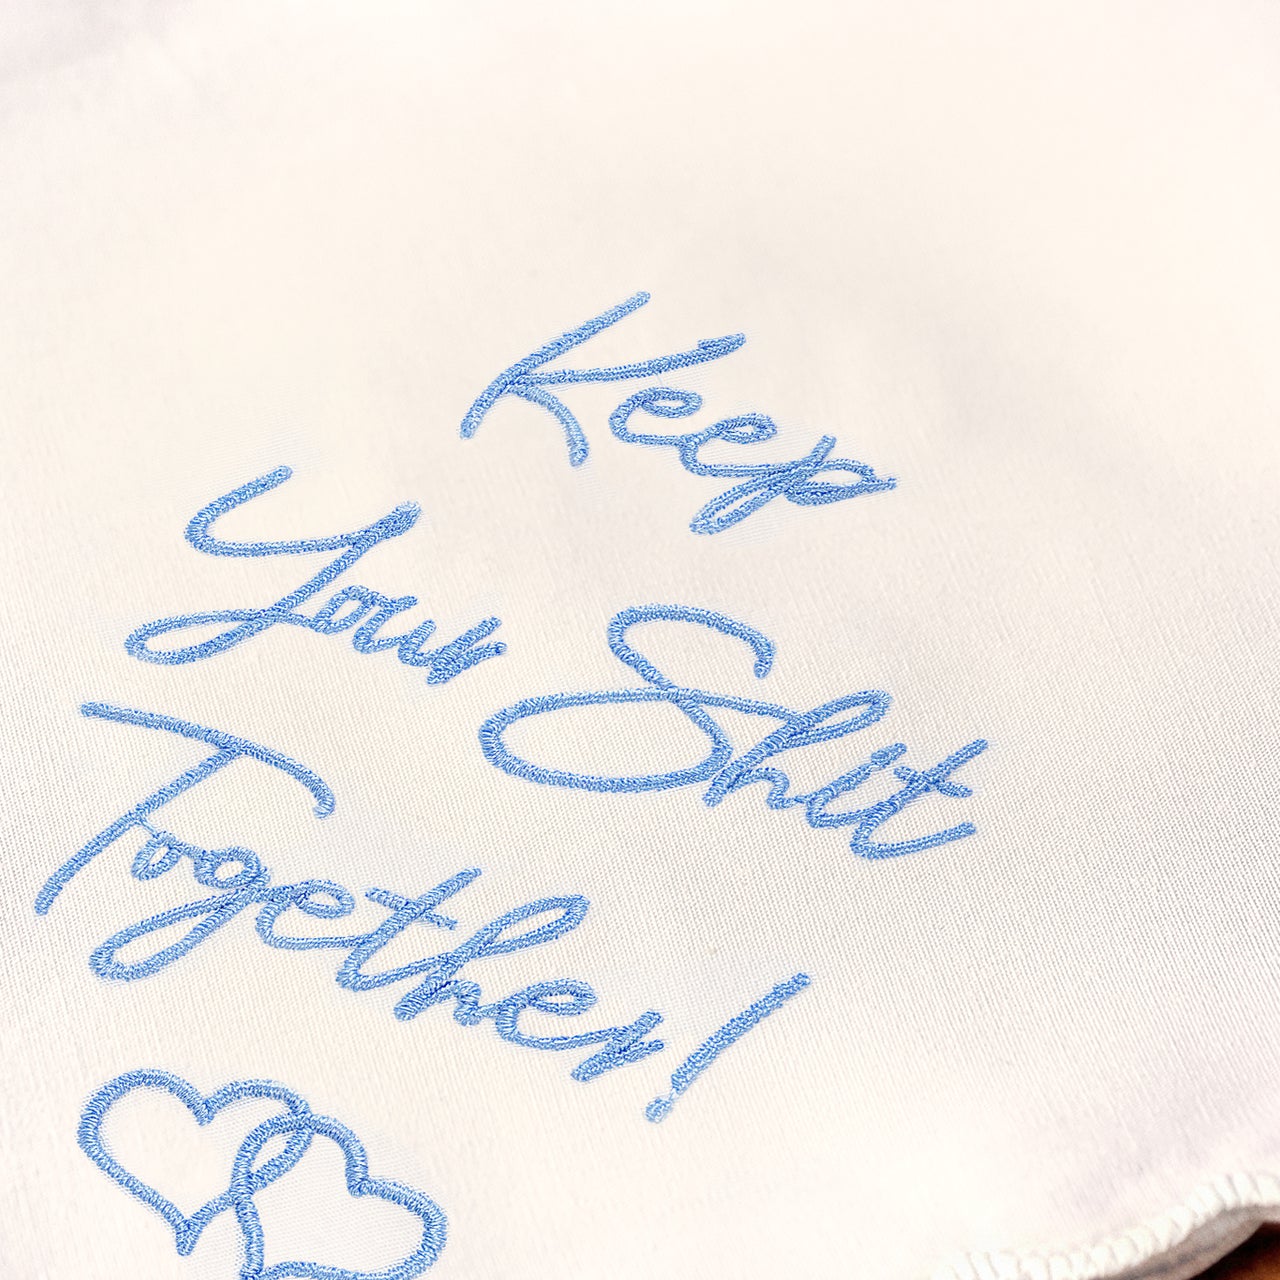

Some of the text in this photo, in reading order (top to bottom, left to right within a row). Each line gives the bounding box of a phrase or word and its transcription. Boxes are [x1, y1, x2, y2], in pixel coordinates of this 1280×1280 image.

[462, 291, 897, 535] Keep
[125, 465, 988, 860] Your Shit
[34, 701, 811, 1122] Together!
